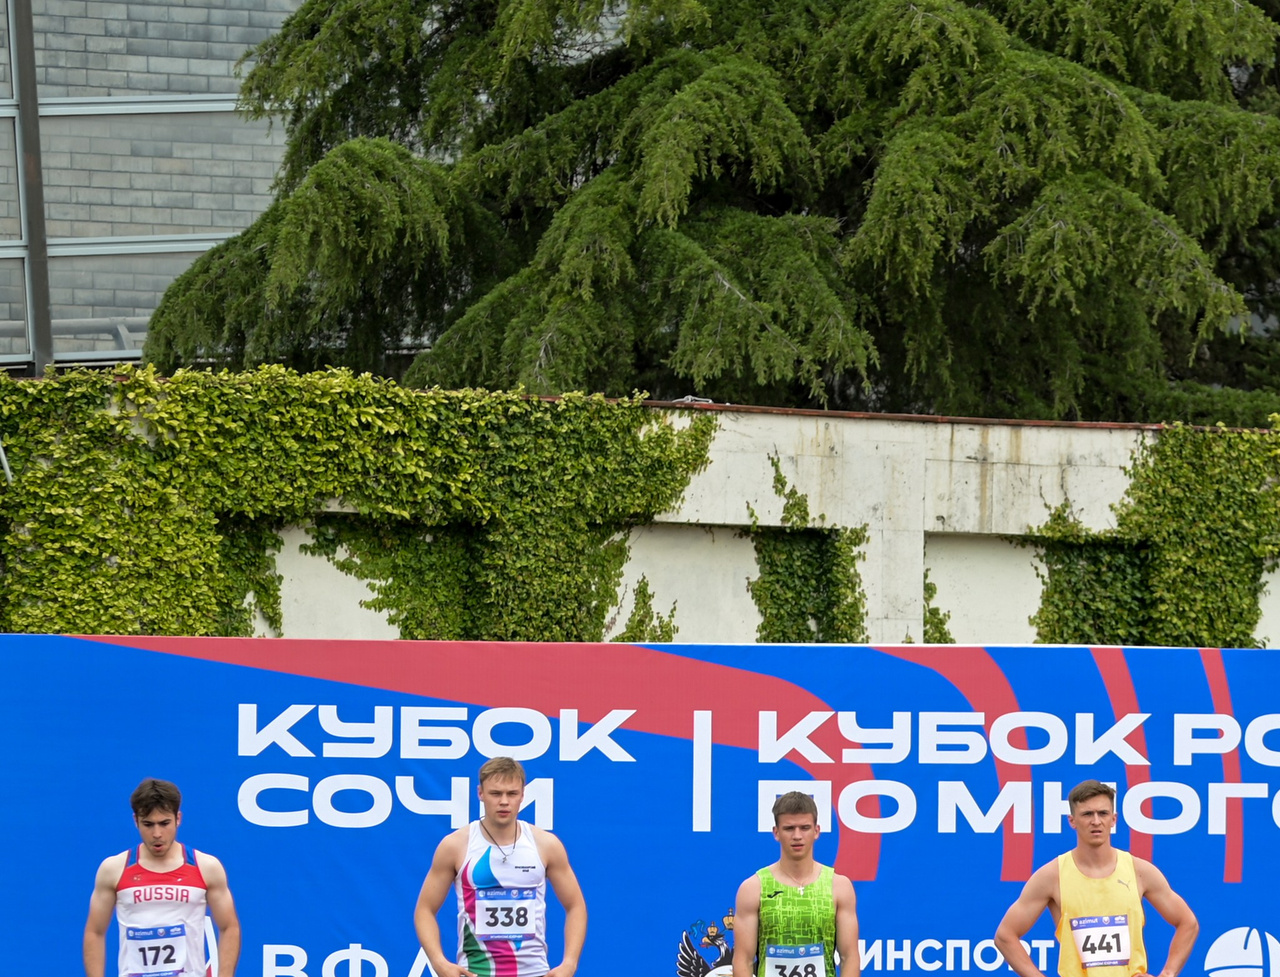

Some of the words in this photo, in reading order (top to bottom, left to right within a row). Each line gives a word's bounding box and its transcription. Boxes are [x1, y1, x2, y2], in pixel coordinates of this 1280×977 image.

[238, 703, 637, 762] КУБОК
[758, 710, 1152, 766] КУБОК
[757, 779, 917, 834] ПО
[133, 887, 190, 904] RUSSIA
[485, 907, 528, 927] 338
[138, 945, 176, 966] 172
[857, 939, 1055, 971] ИНСПОТ
[1082, 933, 1121, 954] 441
